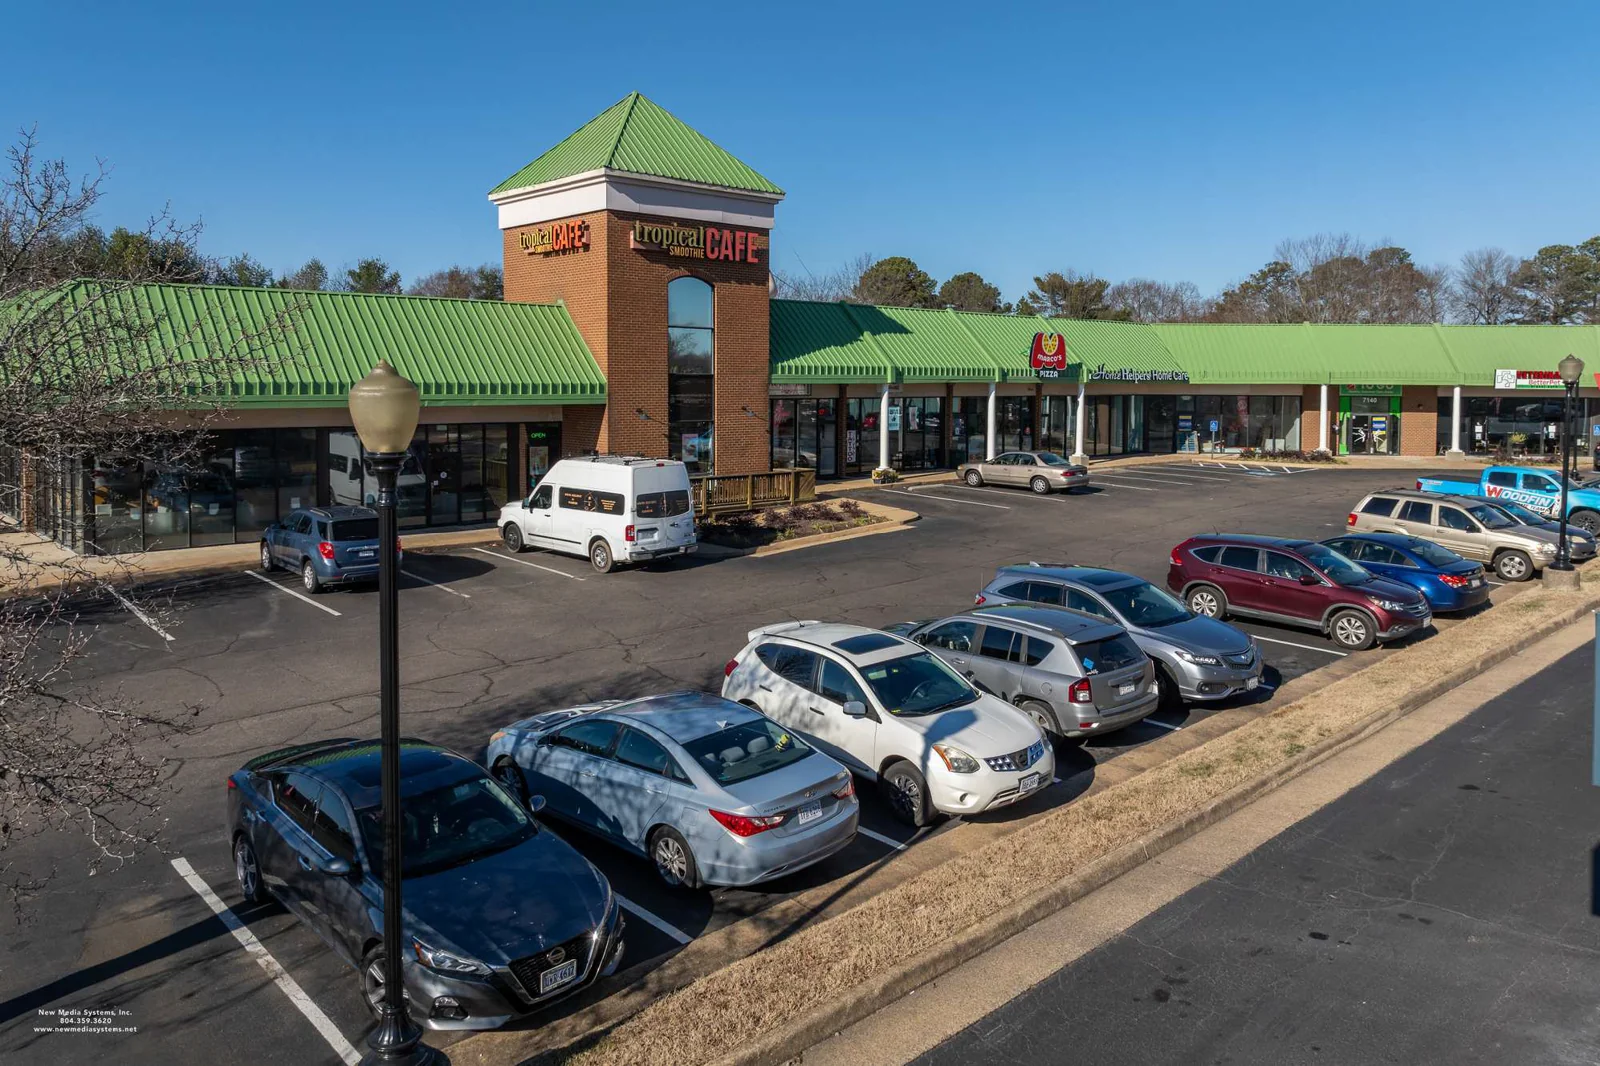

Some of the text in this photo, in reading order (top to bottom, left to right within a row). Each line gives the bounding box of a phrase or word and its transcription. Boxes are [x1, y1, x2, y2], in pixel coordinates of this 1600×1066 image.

[520, 220, 583, 250] tropical CAFE
[634, 220, 759, 263] tropical CAFE
[669, 246, 704, 259] SMOOTHIE
[1092, 363, 1188, 384] Home Helpers Home Care
[1516, 371, 1561, 379] VETERINA
[1487, 485, 1550, 508] WOODFIN
